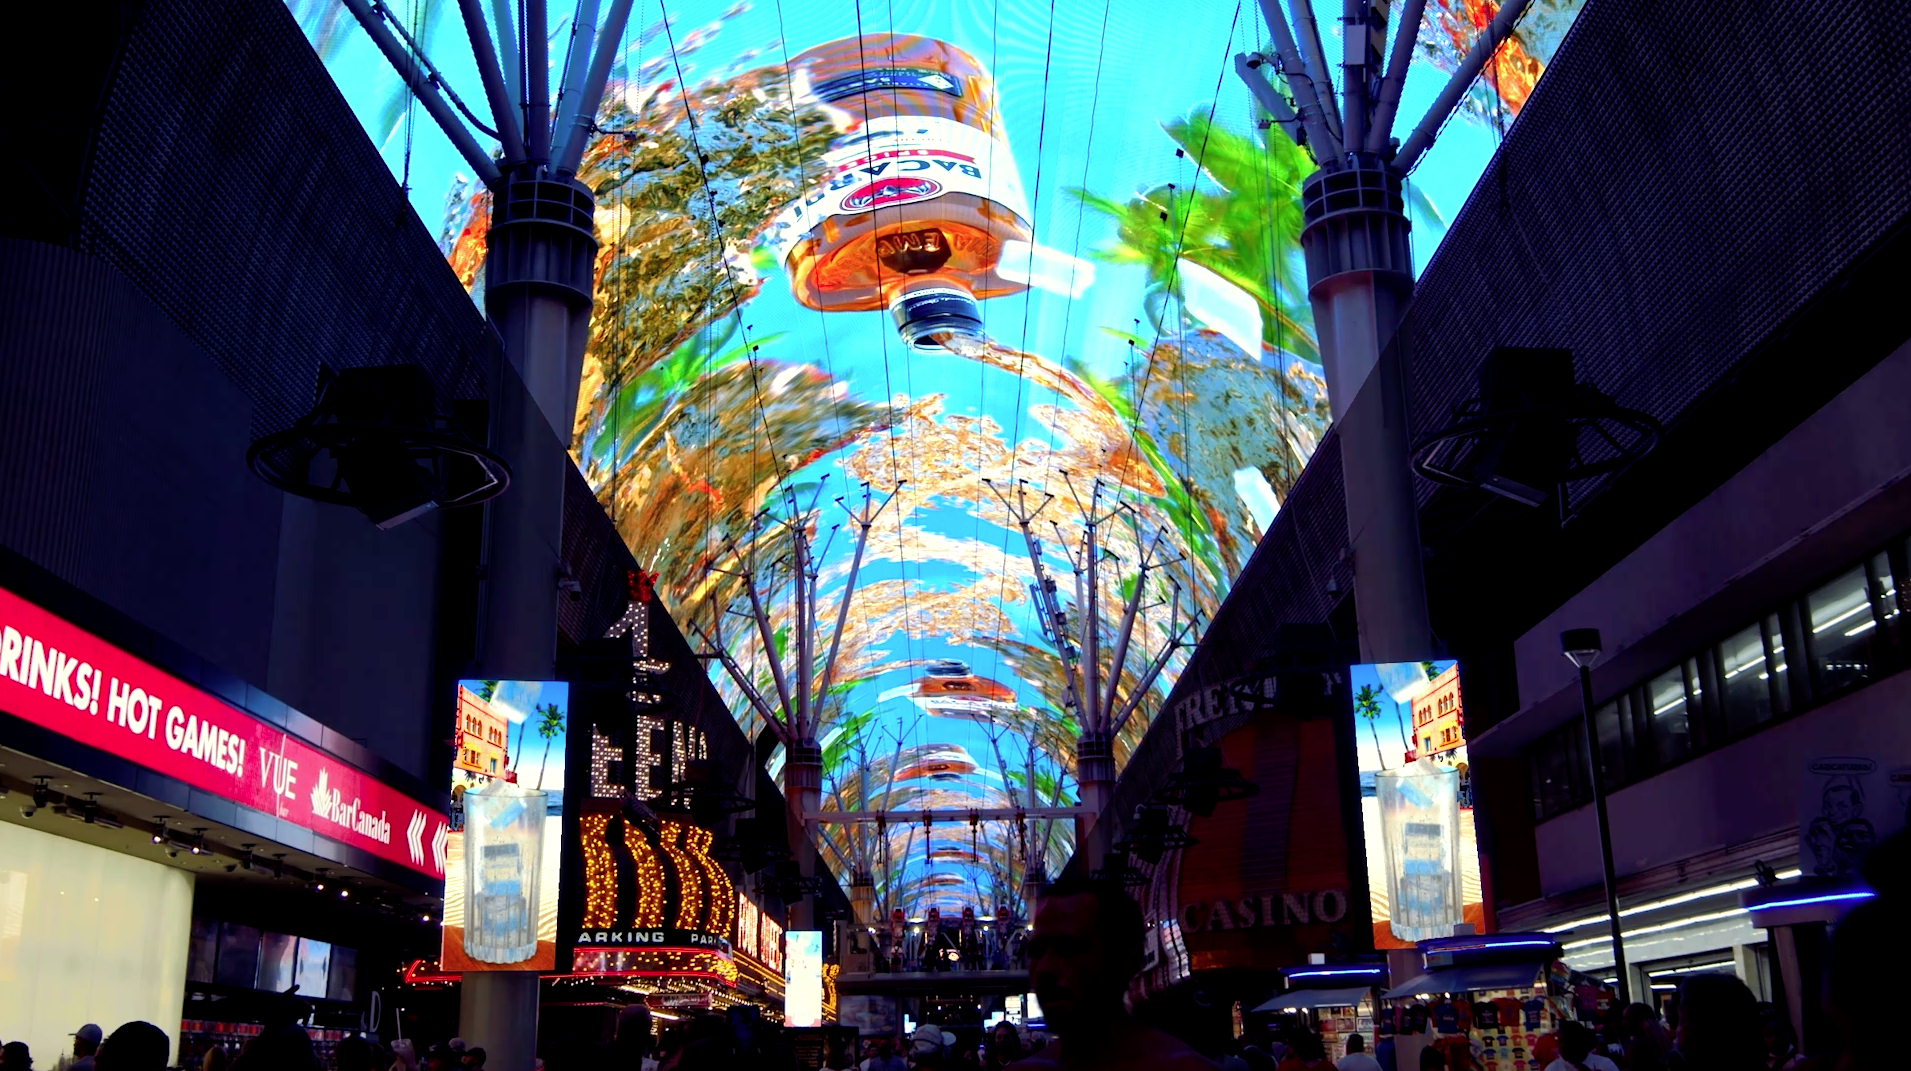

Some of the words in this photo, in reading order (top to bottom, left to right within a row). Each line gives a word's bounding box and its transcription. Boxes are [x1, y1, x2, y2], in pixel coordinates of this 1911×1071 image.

[0, 625, 101, 714] RINKS!
[107, 675, 162, 739] HOT
[166, 707, 246, 778] GAMES!
[259, 745, 298, 800] VUE
[331, 787, 391, 845] BarCanada
[1177, 887, 1348, 934] CASINO
